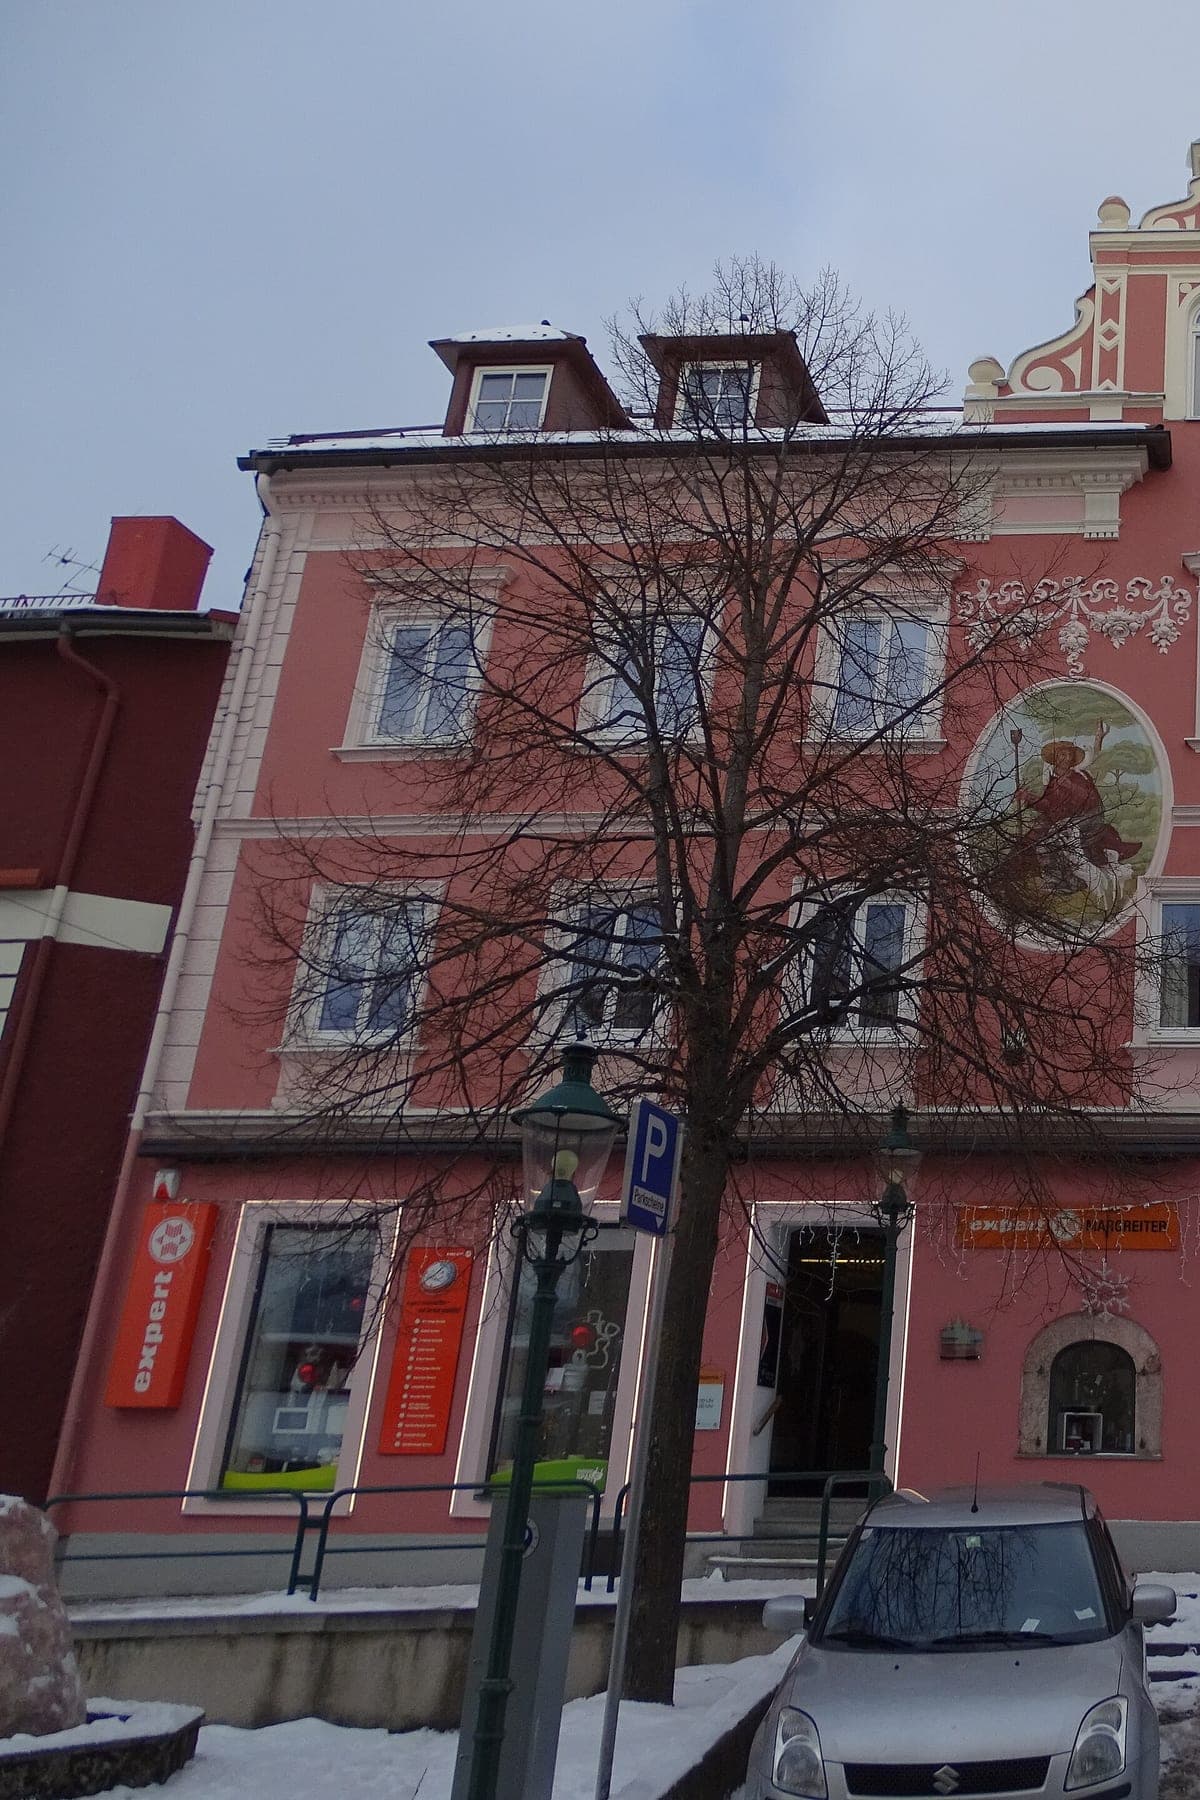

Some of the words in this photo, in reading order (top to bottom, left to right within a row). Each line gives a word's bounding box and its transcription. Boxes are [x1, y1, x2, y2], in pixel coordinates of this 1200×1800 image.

[641, 1113, 668, 1183] P
[1086, 1219, 1168, 1233] MARGREITER
[134, 1270, 173, 1393] expert
